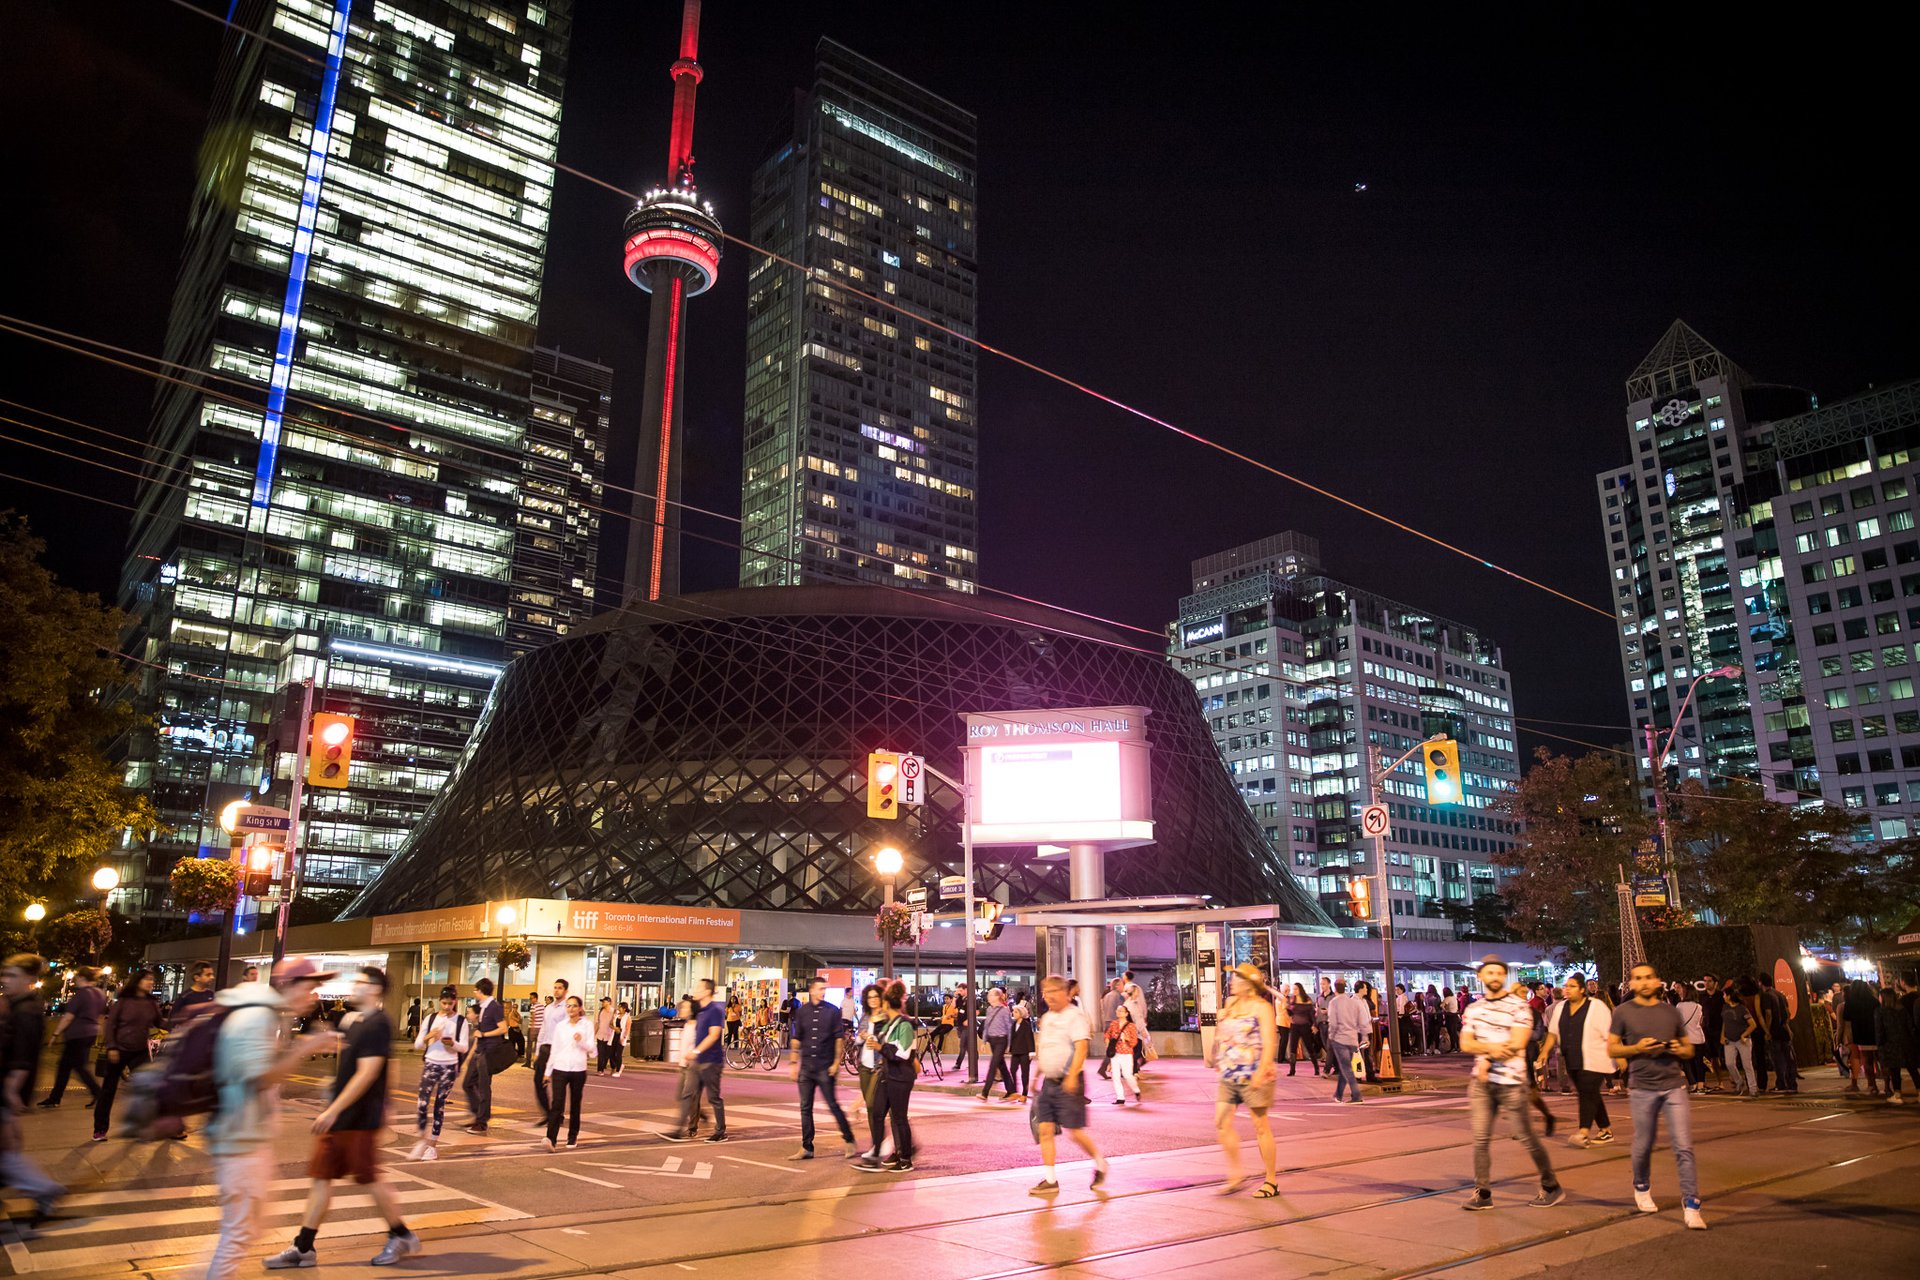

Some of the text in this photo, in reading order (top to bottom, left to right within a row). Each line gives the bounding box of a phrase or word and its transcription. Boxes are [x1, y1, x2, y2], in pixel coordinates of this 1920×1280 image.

[1186, 623, 1224, 642] McCANN
[970, 719, 1130, 738] ROY THOMSON HALL
[246, 815, 265, 828] King
[274, 818, 281, 827] W
[438, 918, 451, 932] Film
[451, 915, 475, 931] Festival
[573, 910, 599, 930] tiff
[603, 923, 618, 932] Sept
[604, 911, 734, 927] Toronto International Film Festival
